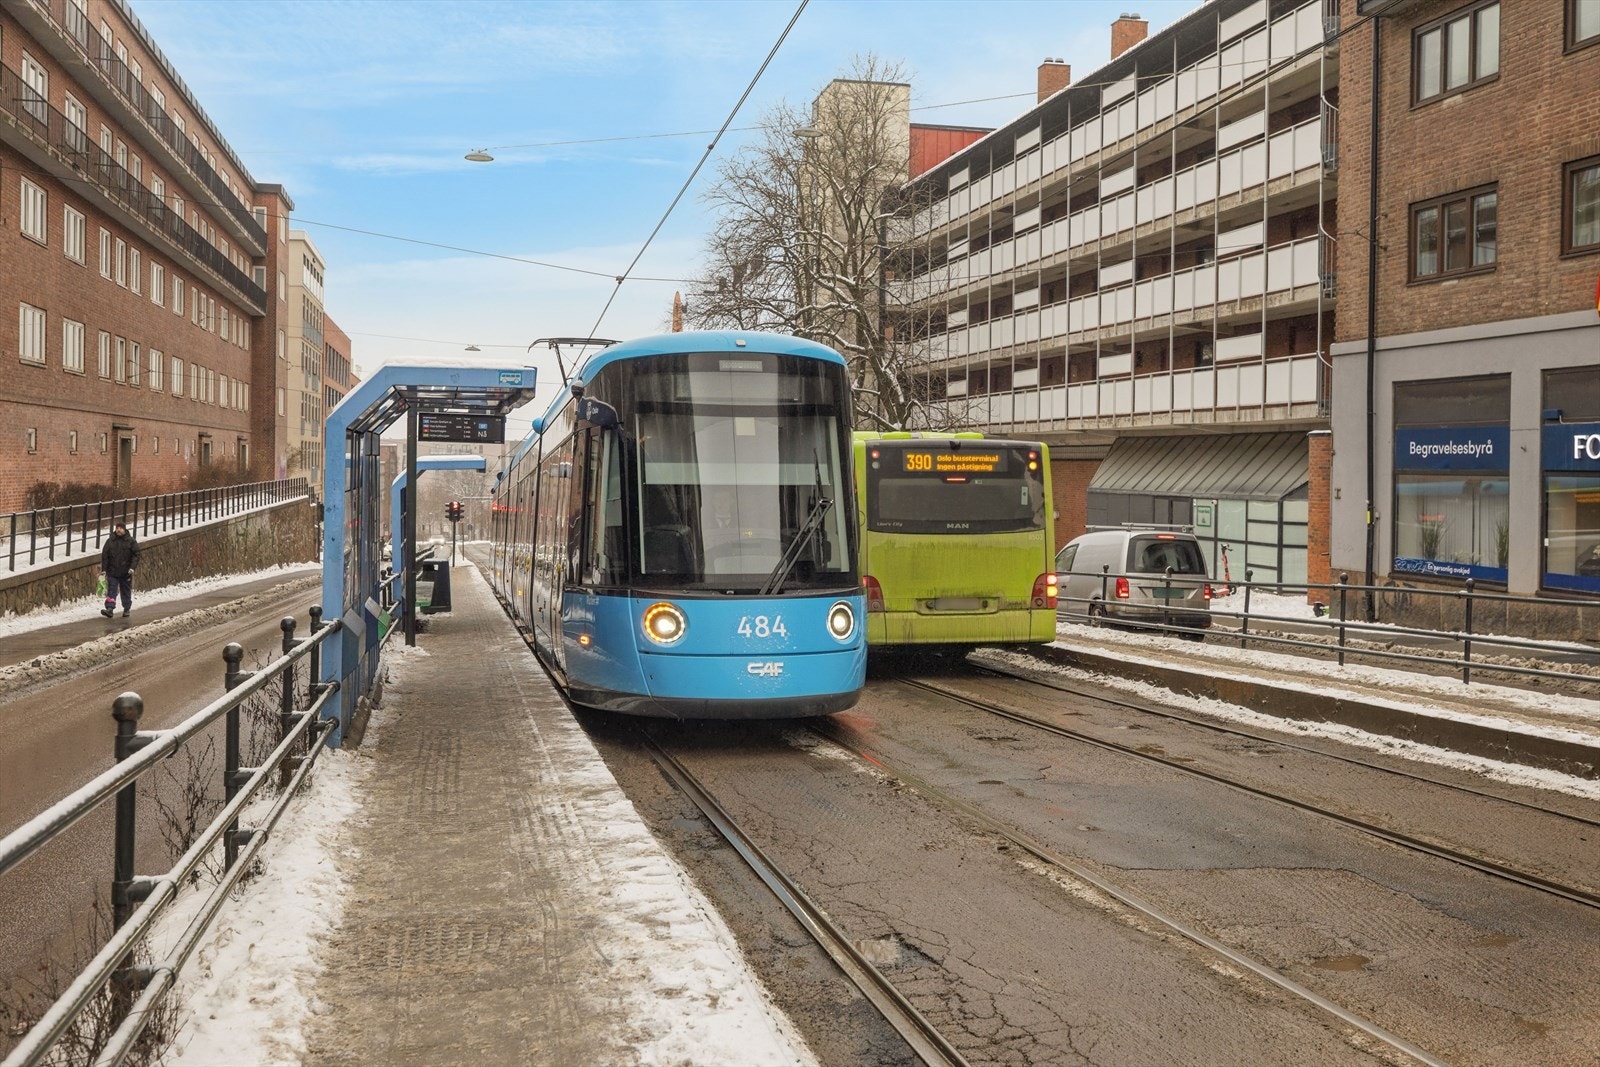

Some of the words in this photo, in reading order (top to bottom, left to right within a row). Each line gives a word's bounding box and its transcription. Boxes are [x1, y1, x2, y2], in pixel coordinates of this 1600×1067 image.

[1409, 439, 1493, 458] Begravelsesbyrå
[906, 454, 932, 470] 390
[953, 454, 998, 462] bussterminal
[957, 463, 993, 471] påstigning
[737, 615, 787, 638] 484
[747, 662, 784, 677] CAF
